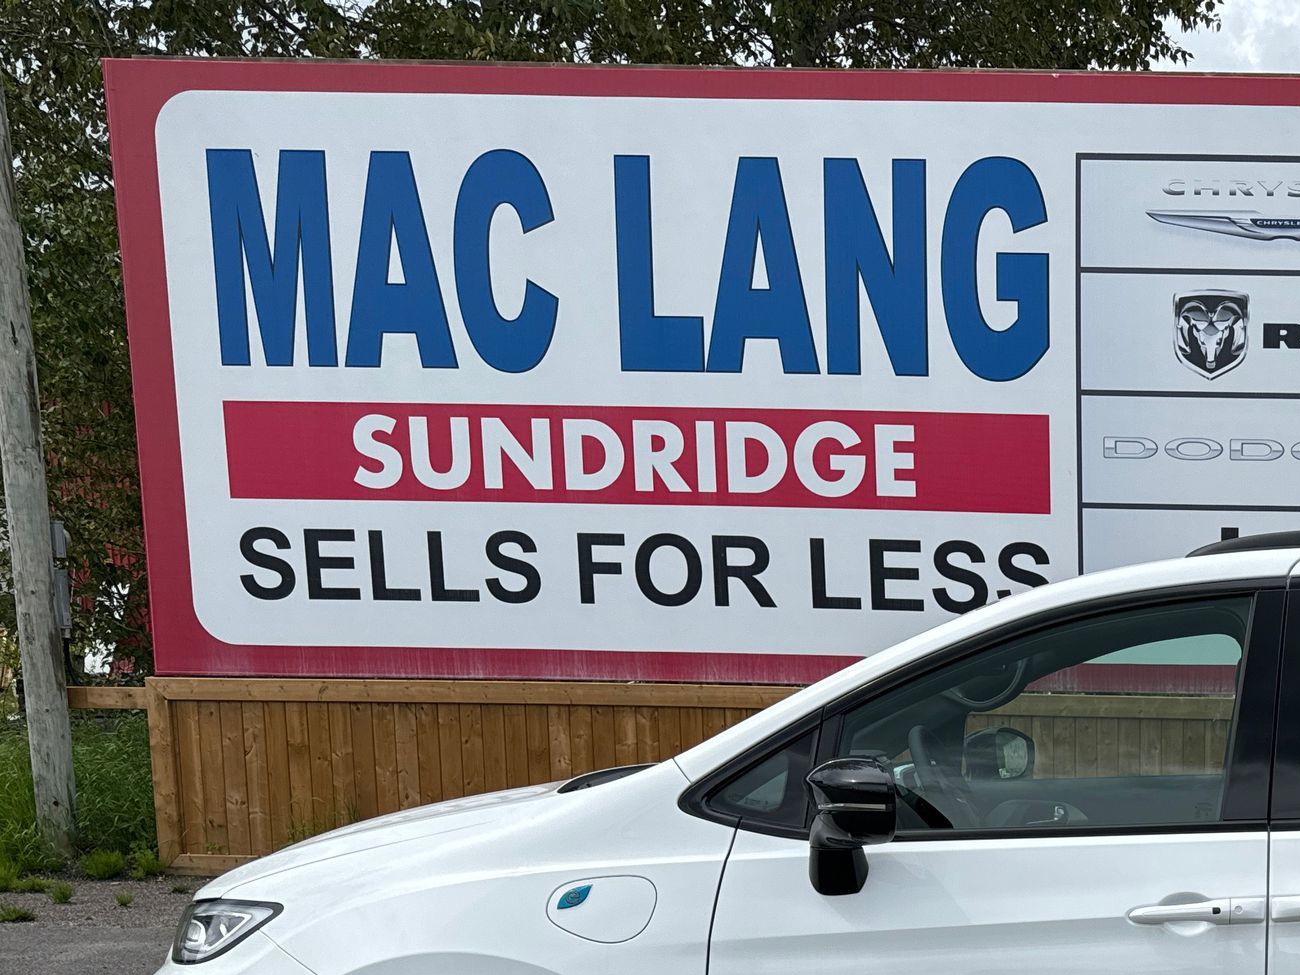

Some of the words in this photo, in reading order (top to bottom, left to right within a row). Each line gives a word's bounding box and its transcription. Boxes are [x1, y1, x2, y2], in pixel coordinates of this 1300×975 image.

[206, 148, 559, 373] MAC
[614, 155, 1050, 382] LANG
[352, 414, 917, 498] SUNDRIDGE
[239, 526, 542, 604] SELLS
[577, 532, 777, 608] FOR
[809, 537, 1050, 615] LESS
